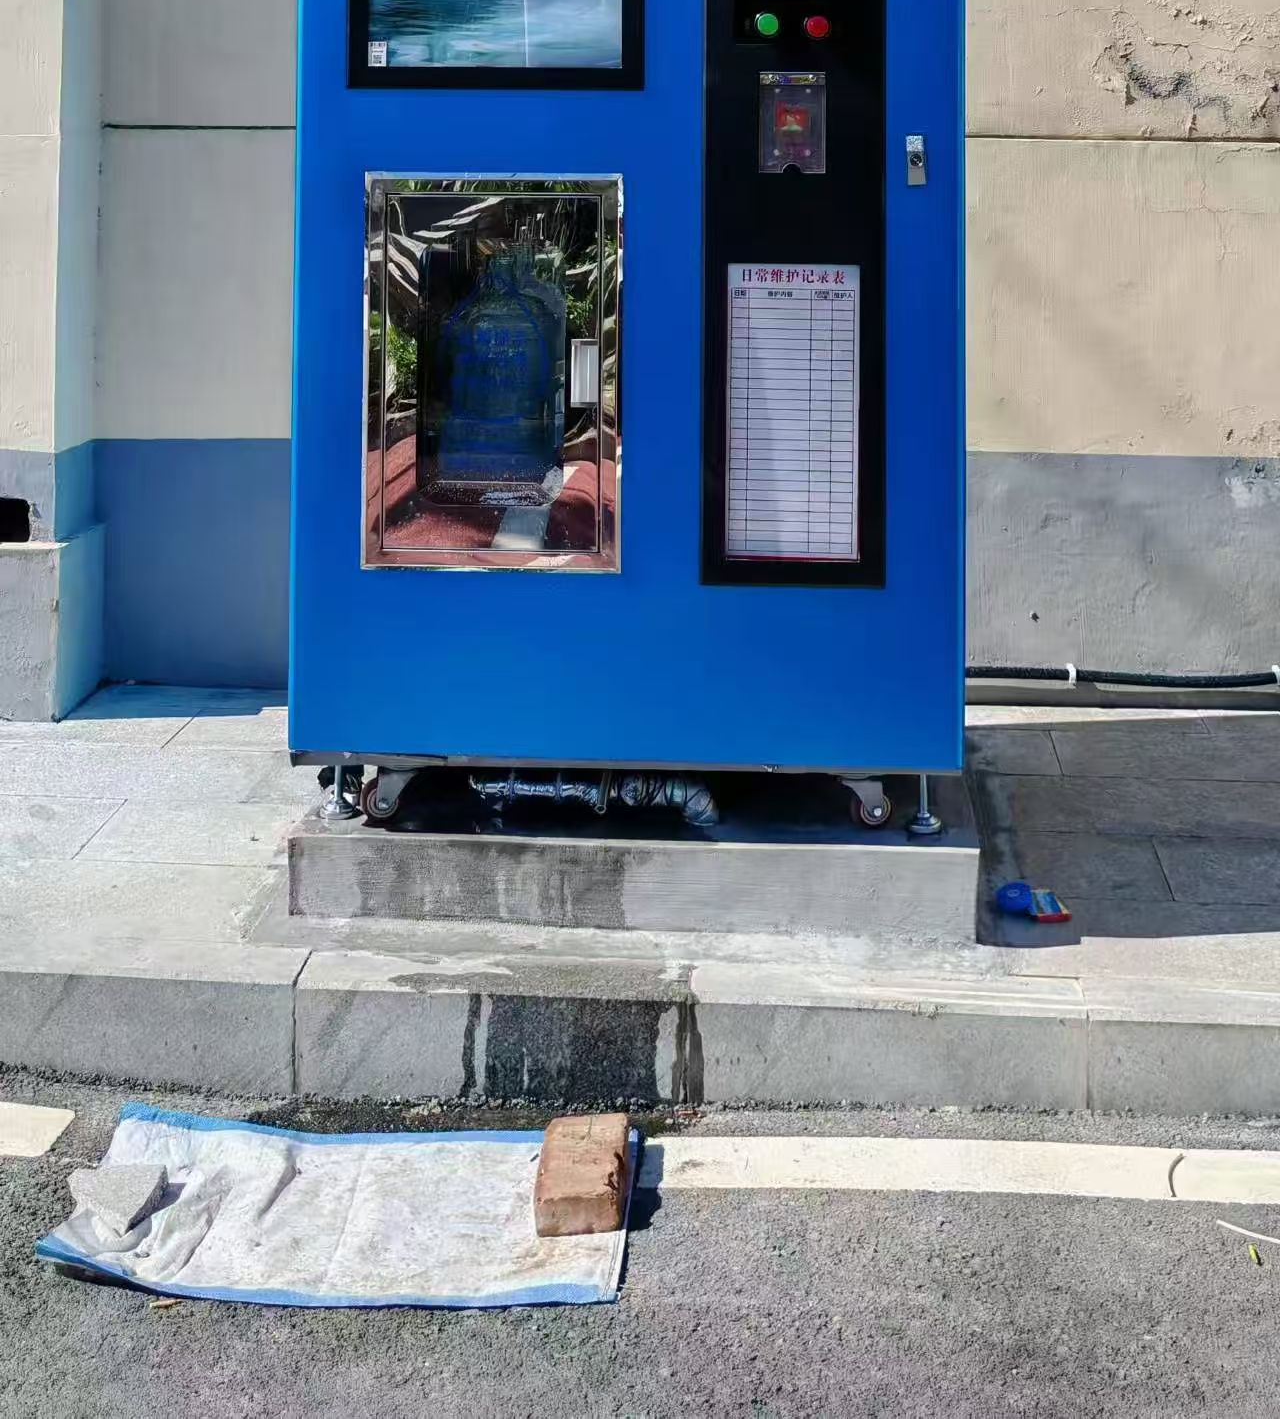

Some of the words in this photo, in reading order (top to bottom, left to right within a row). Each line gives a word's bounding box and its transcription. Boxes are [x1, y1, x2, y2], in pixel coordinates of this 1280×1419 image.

[742, 268, 845, 284] 日常维护记录表
